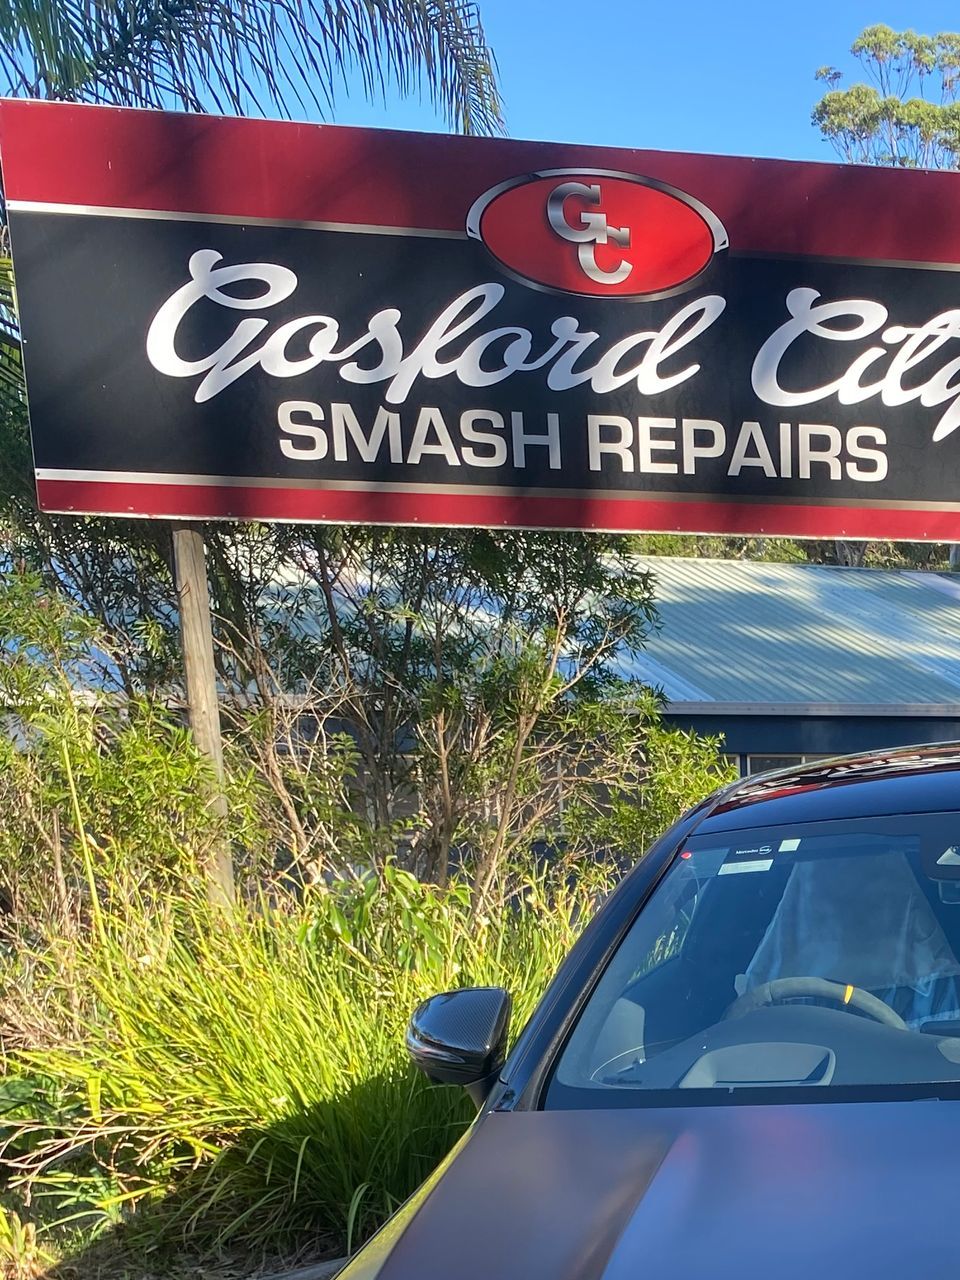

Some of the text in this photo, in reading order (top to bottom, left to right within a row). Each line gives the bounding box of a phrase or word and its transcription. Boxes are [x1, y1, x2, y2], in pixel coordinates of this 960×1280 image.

[145, 248, 727, 405] Gosford
[277, 399, 889, 483] SMASH REPAIRS
